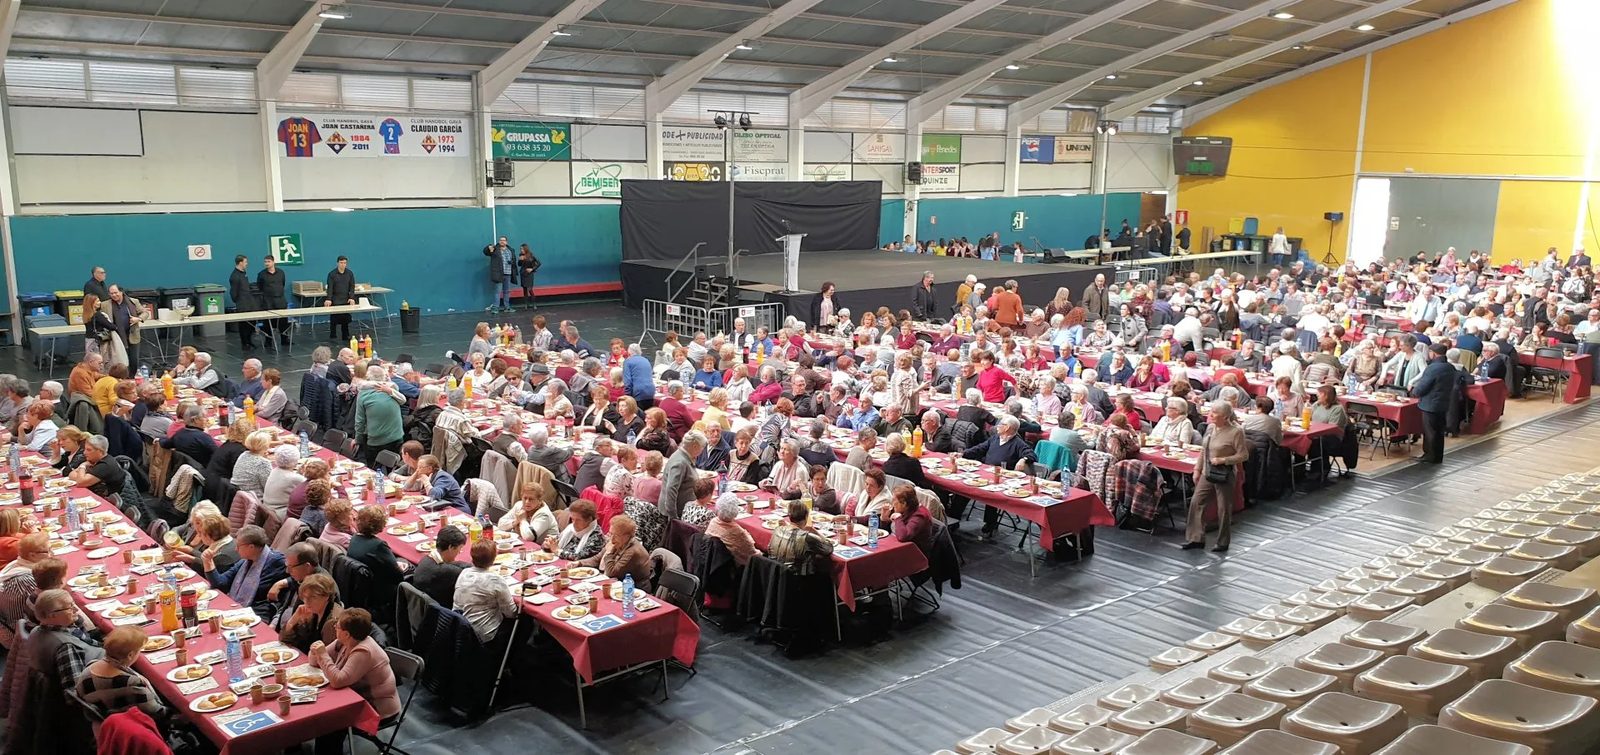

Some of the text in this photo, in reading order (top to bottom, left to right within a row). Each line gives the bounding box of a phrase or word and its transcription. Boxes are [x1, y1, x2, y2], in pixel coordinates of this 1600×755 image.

[288, 123, 308, 133] JOAN
[411, 124, 438, 133] CLAUDIO
[388, 127, 394, 140] 2
[506, 132, 551, 143] GRUPASSA
[686, 132, 724, 140] PUBLICIDAD
[291, 133, 307, 148] 13
[438, 135, 455, 143] 1973
[438, 144, 455, 152] 1994
[506, 143, 516, 151] 93
[542, 144, 551, 152] 20
[744, 166, 785, 177] Fiscprat
